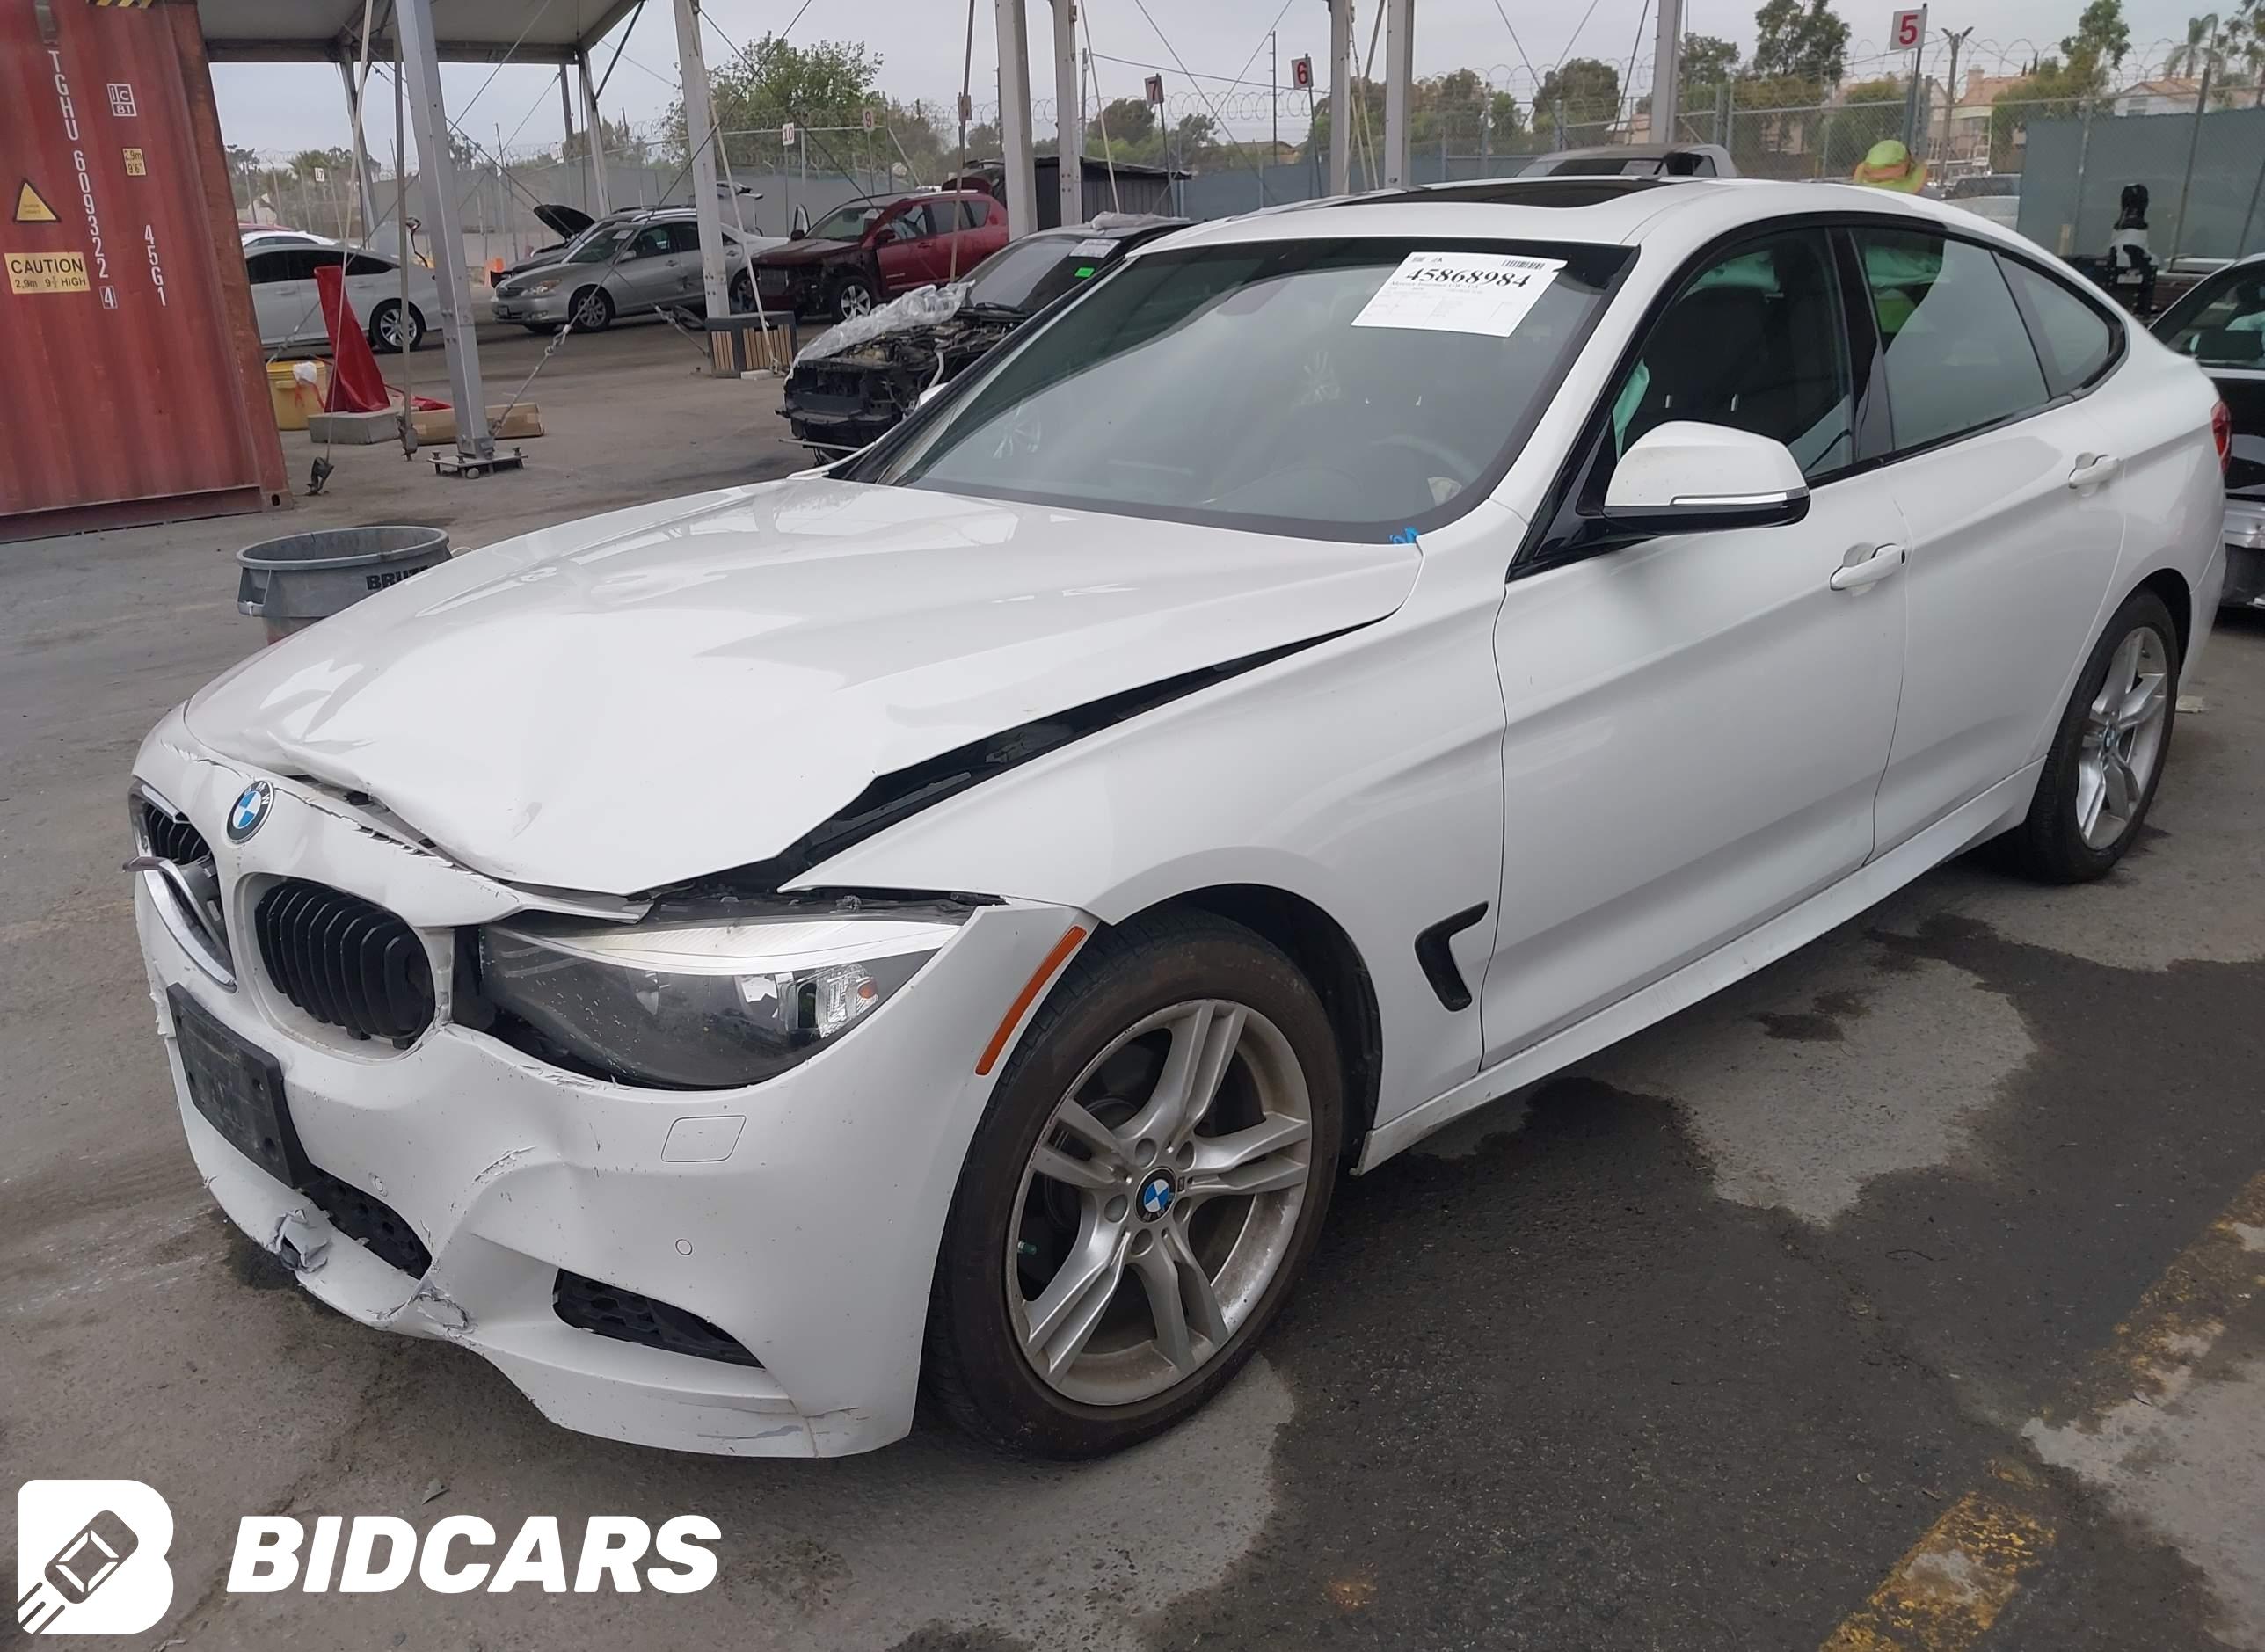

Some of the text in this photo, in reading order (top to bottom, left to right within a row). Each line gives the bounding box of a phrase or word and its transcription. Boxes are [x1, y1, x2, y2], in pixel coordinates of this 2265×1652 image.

[1899, 14, 1918, 44] 5
[1297, 62, 1308, 84] 6
[1148, 80, 1158, 101] 7
[117, 105, 132, 113] 81
[864, 111, 872, 128] 9
[783, 127, 794, 142] 10
[47, 50, 114, 308] TGHU 609322 4
[11, 258, 84, 274] CAUTION
[144, 224, 166, 306] 45G1
[61, 277, 86, 287] HIGH
[1406, 267, 1532, 288] 45868984
